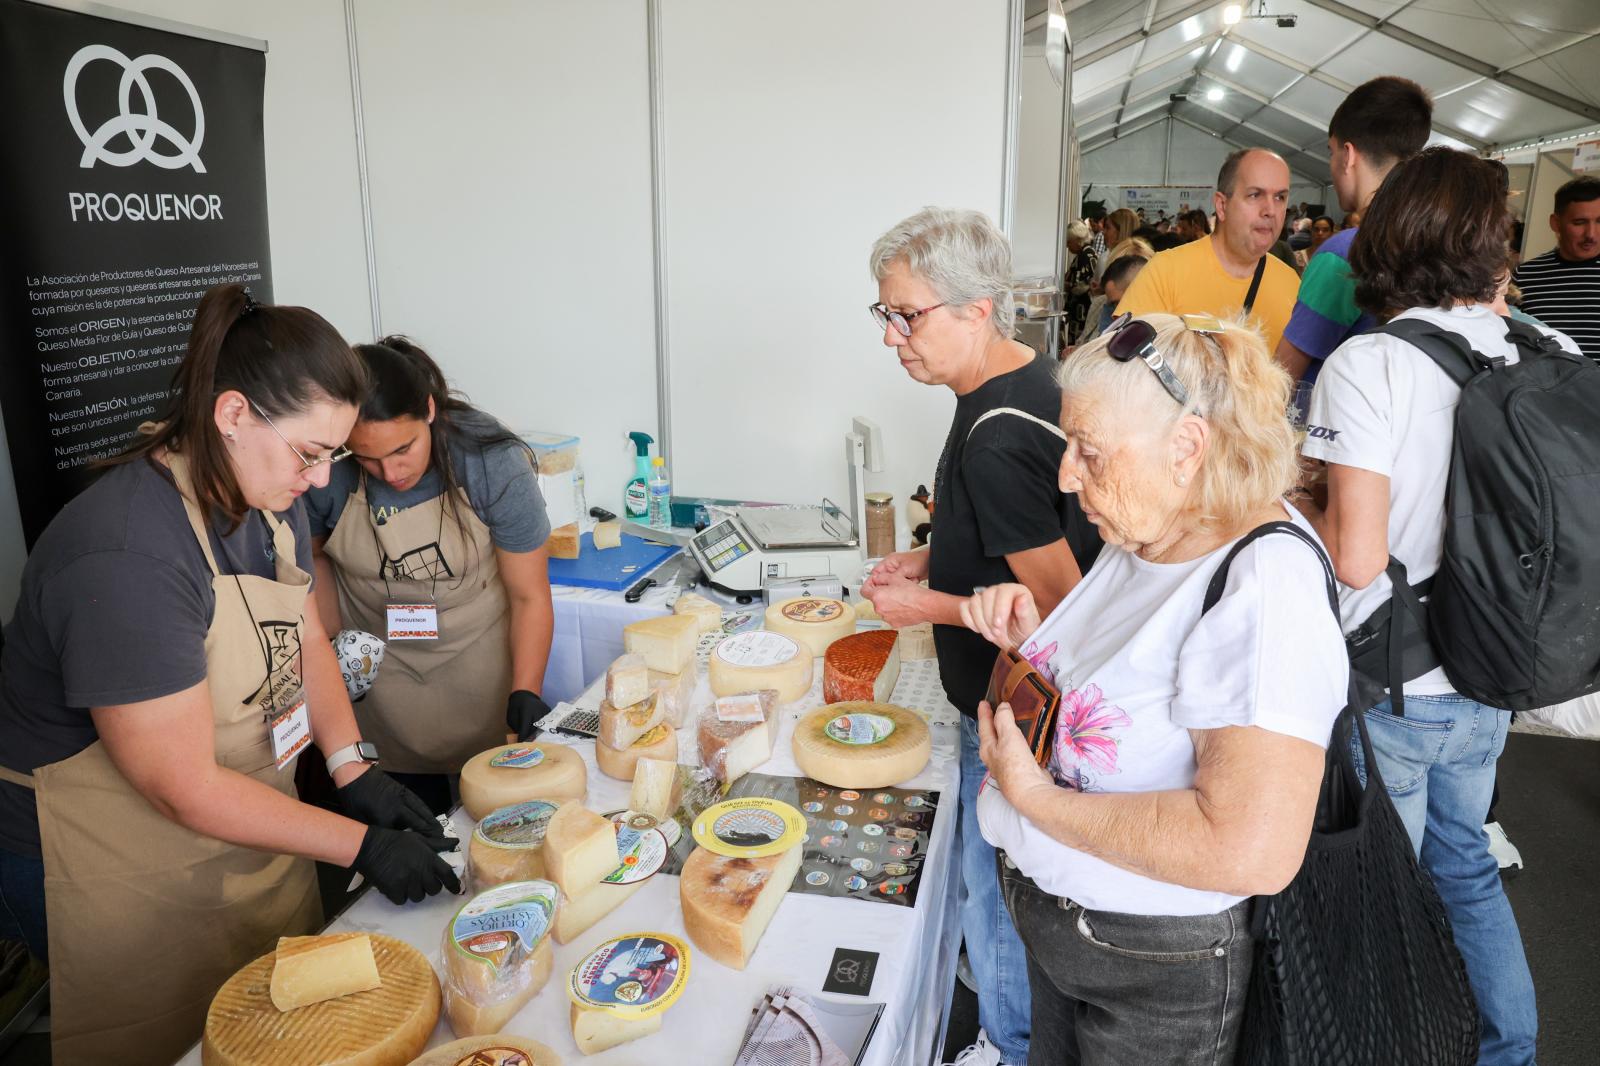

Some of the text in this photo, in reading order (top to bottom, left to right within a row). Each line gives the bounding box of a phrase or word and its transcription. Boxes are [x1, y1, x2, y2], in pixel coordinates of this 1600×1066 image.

[68, 192, 223, 222] PROQUENOR
[26, 276, 40, 286] La
[42, 273, 89, 285] Asociación
[90, 272, 100, 282] de
[100, 268, 144, 281] Productores
[145, 269, 154, 278] de
[154, 267, 178, 277] Queso
[180, 265, 210, 275] Artesanal
[211, 263, 221, 272] del
[221, 263, 247, 272] Noroeste
[29, 288, 69, 301] formada
[70, 289, 84, 299] por
[85, 285, 119, 298] queseros
[120, 286, 124, 295] y
[125, 281, 157, 294] queseras
[158, 279, 191, 289] artesanas
[192, 278, 200, 286] de
[201, 277, 208, 285] la
[208, 276, 218, 284] isla
[219, 275, 227, 283] de
[227, 274, 241, 283] Gran
[31, 305, 55, 317] cuya
[56, 302, 84, 313] misión
[85, 302, 95, 310] es
[95, 300, 102, 309] la
[102, 299, 113, 308] de
[113, 295, 146, 308] potenciar
[146, 295, 153, 304] la
[154, 290, 194, 304] producción
[35, 326, 69, 338] Somos
[70, 323, 78, 334] el
[78, 317, 126, 332] ORIGEN
[126, 319, 131, 328] y
[131, 316, 138, 325] la
[138, 314, 165, 325] esencia
[165, 312, 174, 320] de
[175, 311, 182, 320] la
[37, 341, 70, 352] Queso
[70, 336, 96, 348] Media
[96, 334, 110, 344] Flor
[111, 332, 121, 342] de
[143, 327, 167, 337] Queso
[167, 324, 177, 333] de
[41, 361, 77, 373] Nuestro
[138, 347, 149, 357] dar
[150, 346, 166, 355] valor
[43, 376, 72, 387] forma
[72, 368, 107, 382] artesanal
[113, 366, 125, 375] dar
[131, 360, 159, 371] conocer
[160, 358, 166, 366] la
[49, 409, 84, 422] Nuestra
[130, 396, 136, 404] la
[137, 390, 165, 404] defensa
[51, 426, 70, 437] que
[71, 422, 87, 432] son
[87, 415, 113, 429] únicos
[113, 414, 123, 422] en
[123, 411, 130, 420] el
[1306, 424, 1341, 442] FOX
[54, 442, 90, 457] Nuestra
[90, 436, 109, 449] sede
[109, 435, 119, 443] se
[56, 460, 70, 471] de
